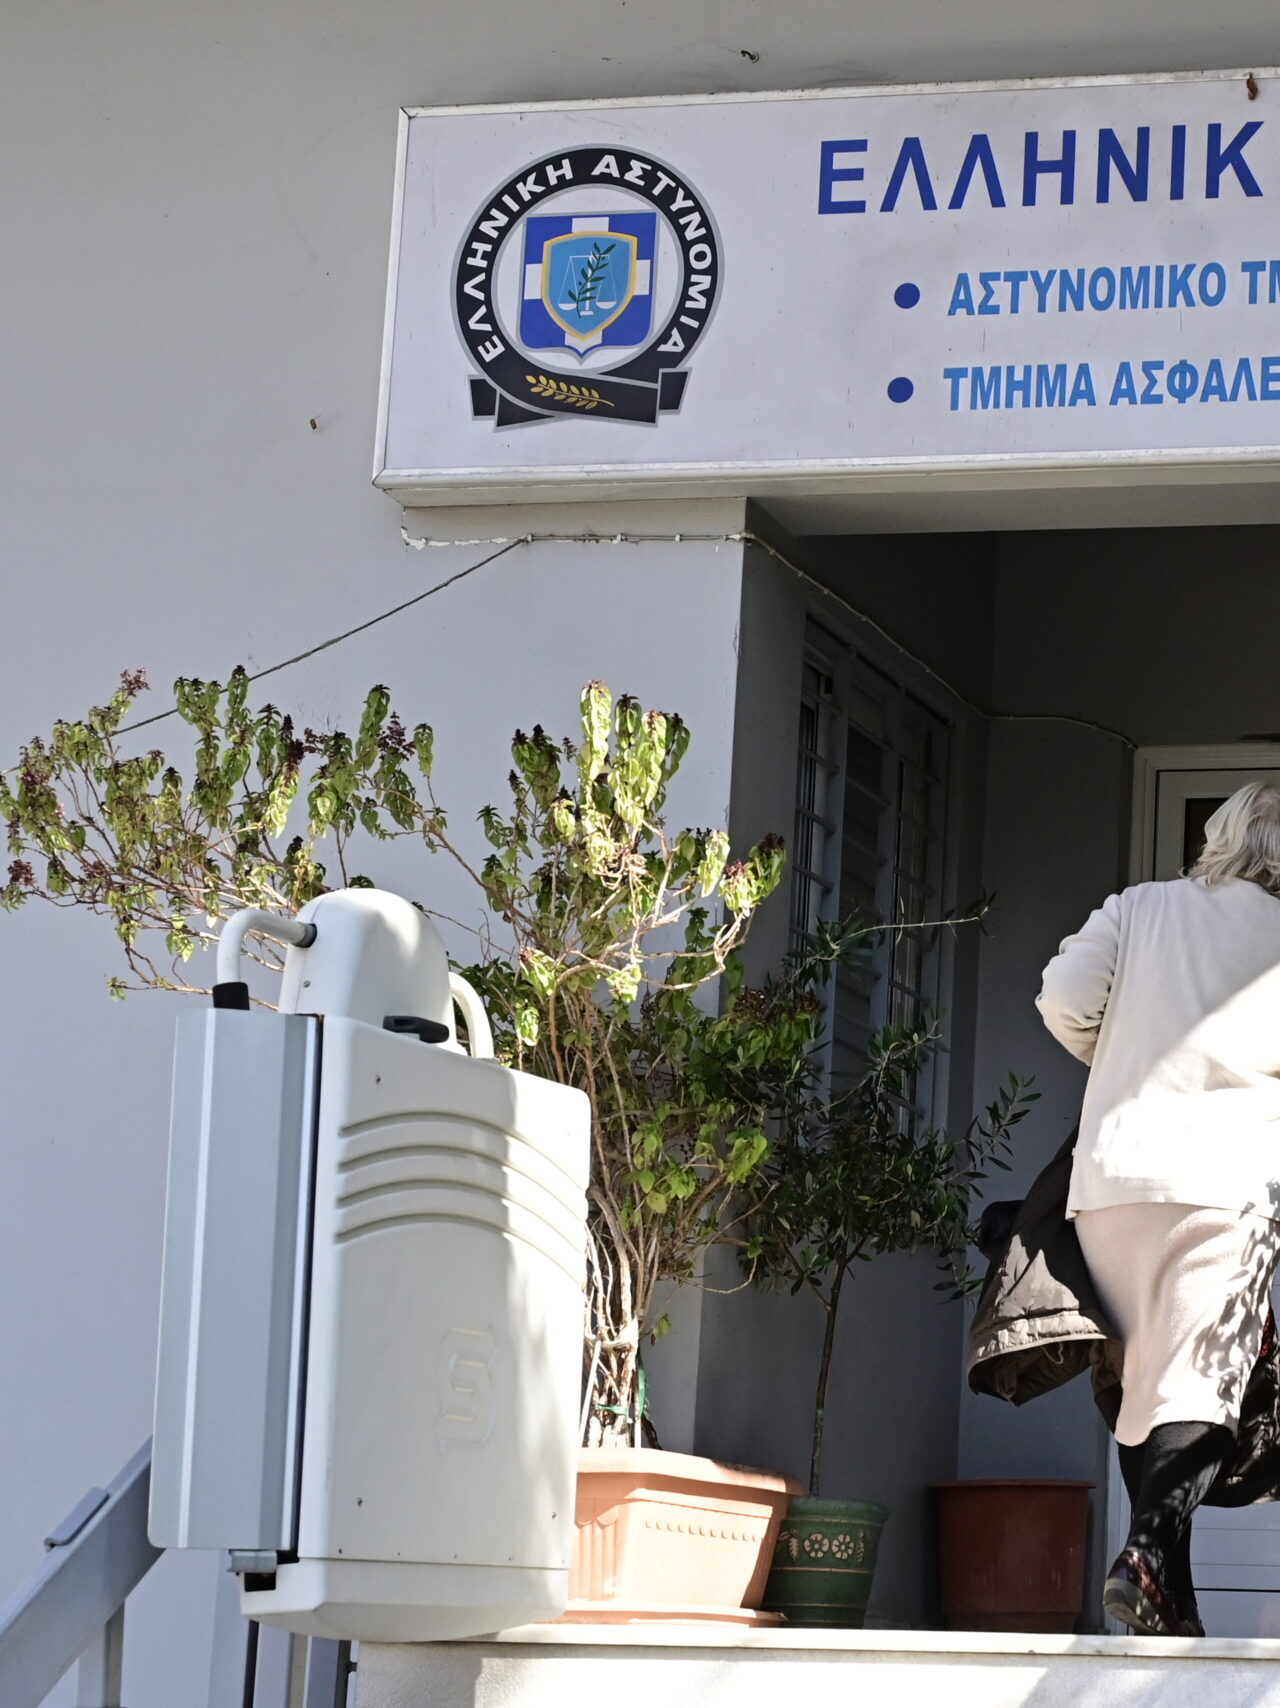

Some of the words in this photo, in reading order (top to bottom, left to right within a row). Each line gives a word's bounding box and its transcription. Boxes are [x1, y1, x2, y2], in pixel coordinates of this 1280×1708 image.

[463, 158, 574, 363] ΕΛΛΗΝΙΚΗ
[591, 154, 713, 353] ΑΣΤΥΝΟΜΙΑ
[947, 264, 1229, 316] ΑΣΤΥΝΟΜΙΚΟ
[943, 362, 1098, 412] ΤΜΗΜΑ
